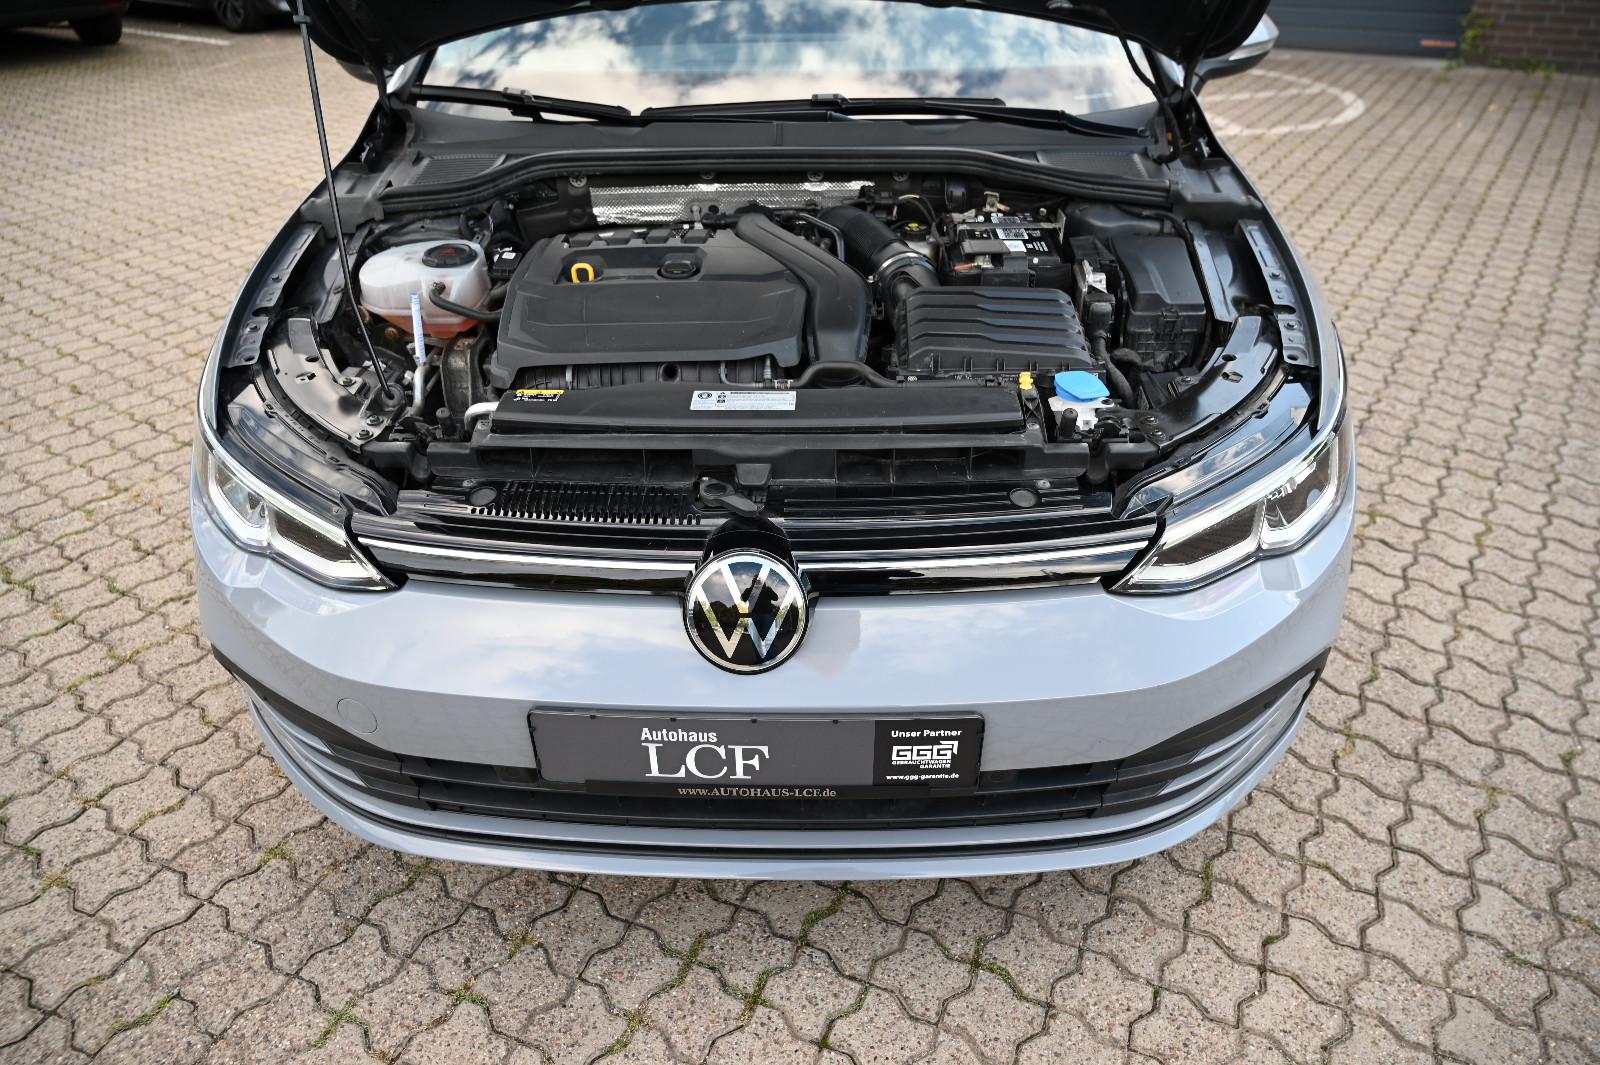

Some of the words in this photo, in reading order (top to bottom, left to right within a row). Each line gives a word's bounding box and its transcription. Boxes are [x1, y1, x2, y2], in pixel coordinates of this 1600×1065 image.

[640, 727, 718, 743] Autohaus
[891, 730, 921, 738] Unser
[923, 729, 962, 737] Partner
[892, 741, 957, 760] GGG
[641, 742, 770, 779] LCF
[886, 773, 960, 781] www.ggg-garantie.de
[678, 787, 837, 798] www.AUTOHAUS-LCF.de
